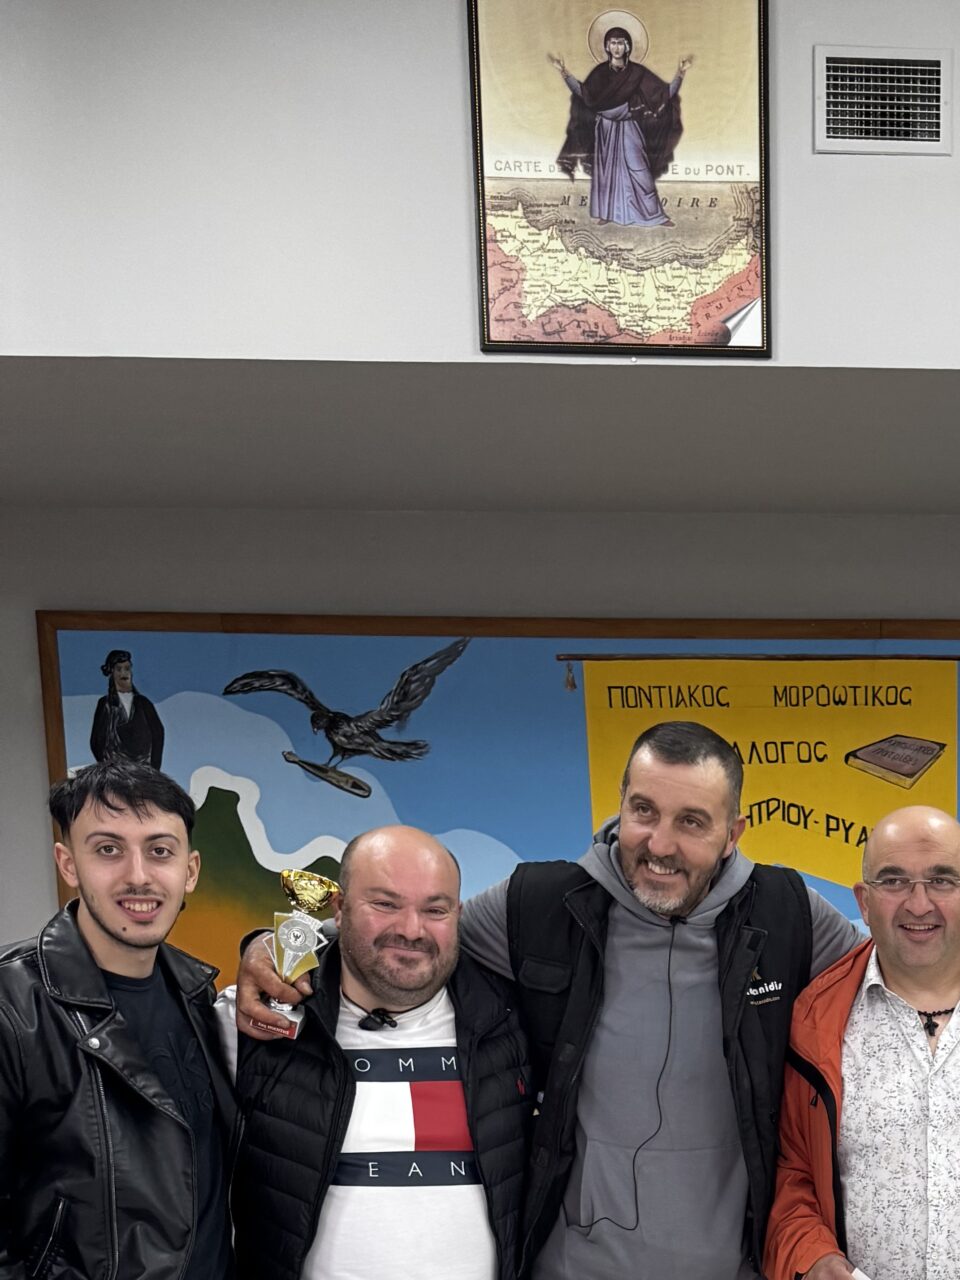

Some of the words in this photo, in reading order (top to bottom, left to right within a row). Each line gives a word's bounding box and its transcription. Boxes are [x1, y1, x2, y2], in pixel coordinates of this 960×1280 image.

[494, 159, 542, 173] CARTE
[560, 195, 589, 207] ME
[661, 197, 718, 208] OIRE
[354, 1056, 457, 1072] OMM
[368, 1161, 466, 1177] EAN
